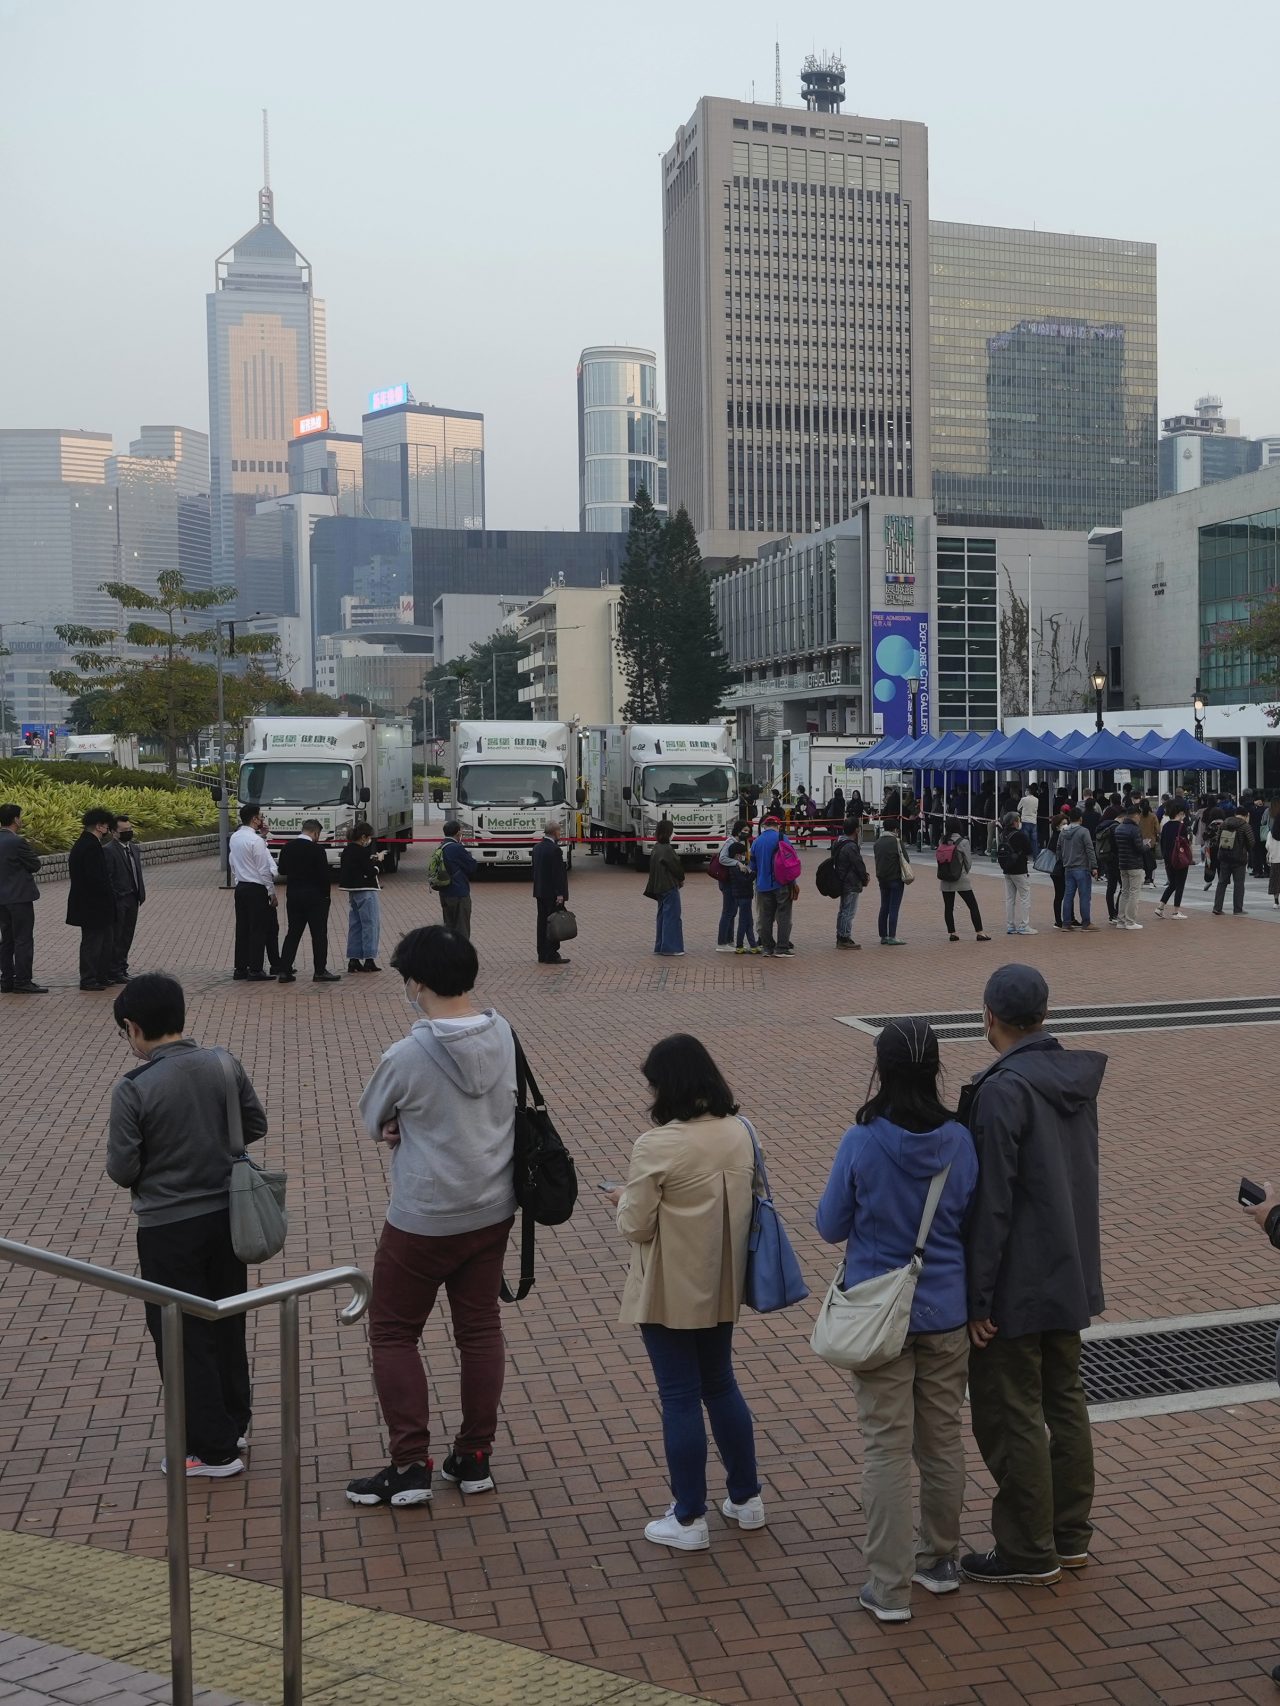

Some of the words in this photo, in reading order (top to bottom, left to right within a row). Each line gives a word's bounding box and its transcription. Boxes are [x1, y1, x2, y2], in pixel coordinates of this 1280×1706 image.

[919, 623, 928, 666] EXPLORE
[920, 669, 929, 691] CITY
[487, 817, 536, 827] MedFort
[671, 813, 714, 822] MedFort
